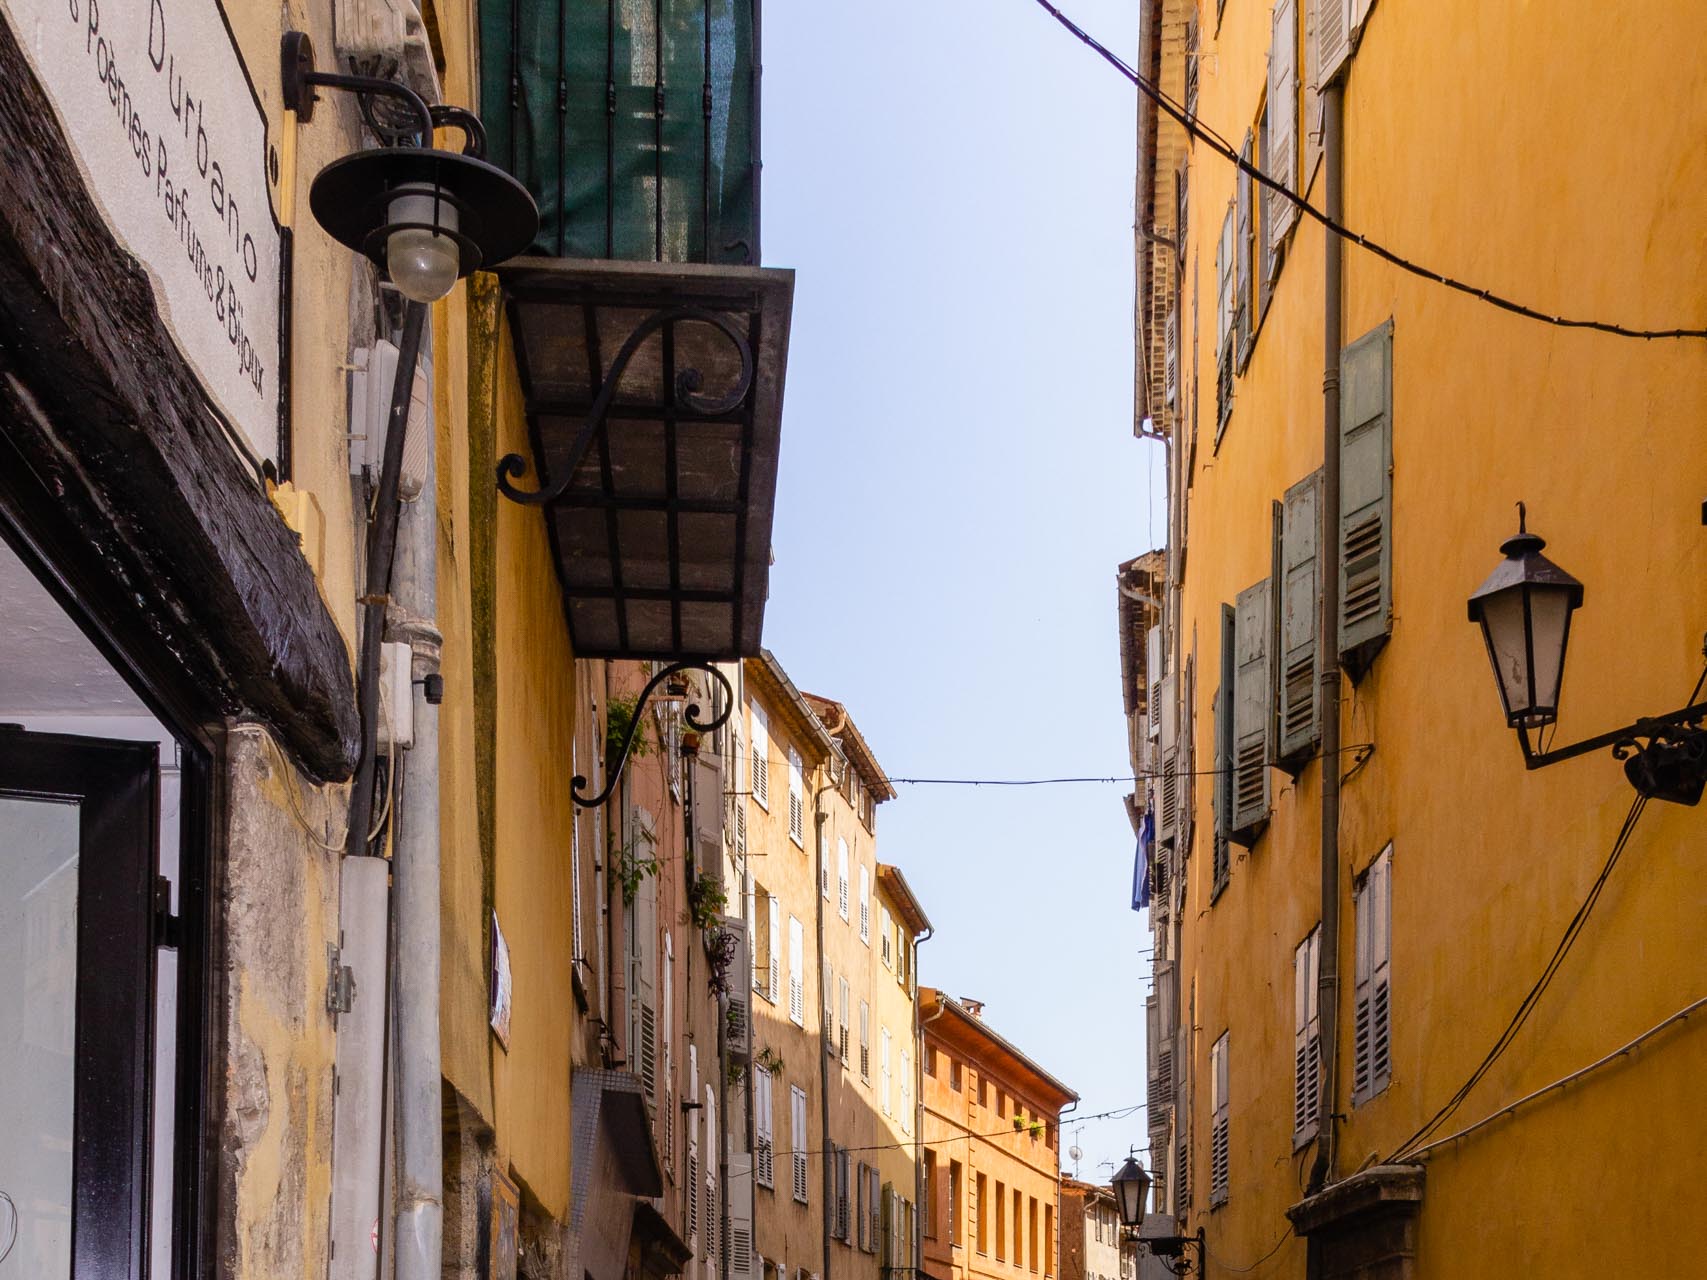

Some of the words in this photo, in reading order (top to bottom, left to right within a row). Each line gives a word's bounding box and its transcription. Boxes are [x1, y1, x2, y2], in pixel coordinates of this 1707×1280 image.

[87, 0, 151, 178] Poèmes
[157, 134, 214, 302] Parfums
[216, 264, 226, 329] &
[228, 279, 265, 400] Bijoux
[148, 0, 257, 283] Durbano
